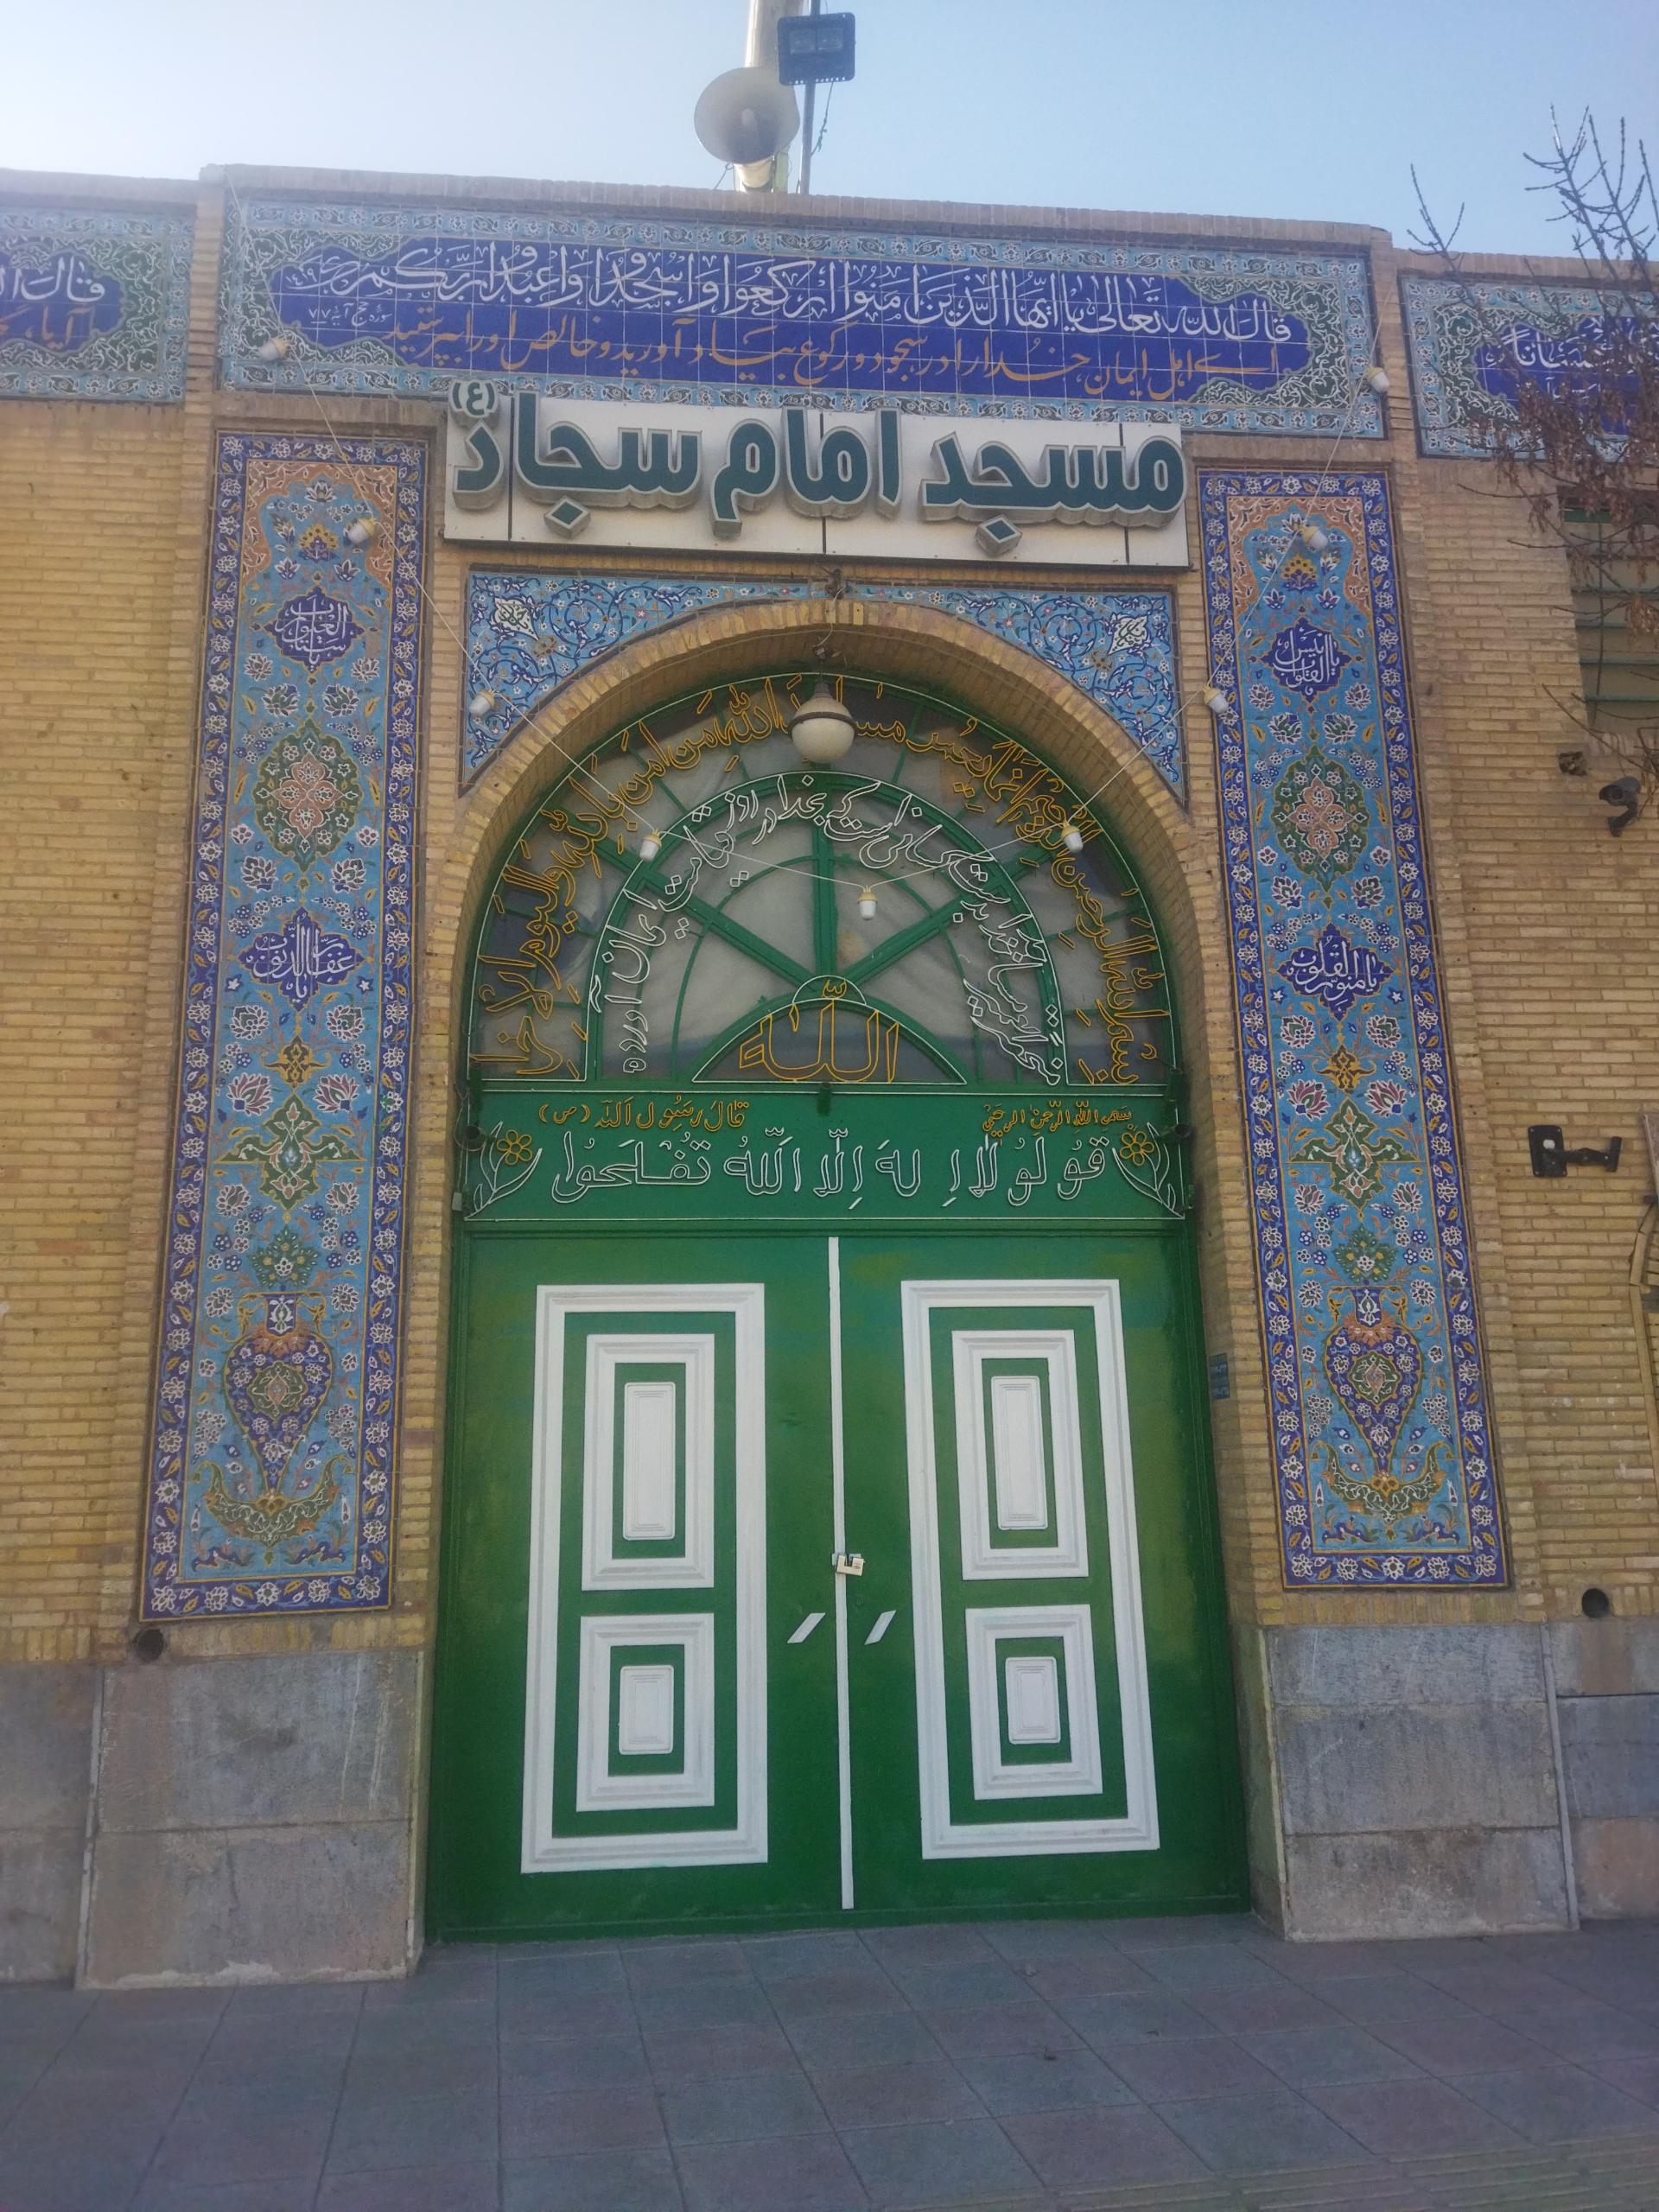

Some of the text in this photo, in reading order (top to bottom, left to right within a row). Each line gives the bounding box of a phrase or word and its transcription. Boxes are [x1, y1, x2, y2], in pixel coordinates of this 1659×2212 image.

[1163, 303, 1234, 335] الله
[1223, 298, 1291, 341] قال
[453, 391, 702, 530] سجاد
[711, 406, 902, 524] امام
[921, 431, 1187, 543] مسجد
[740, 979, 899, 1084] الله
[635, 1102, 704, 1130] رسول
[704, 1100, 750, 1132] قال
